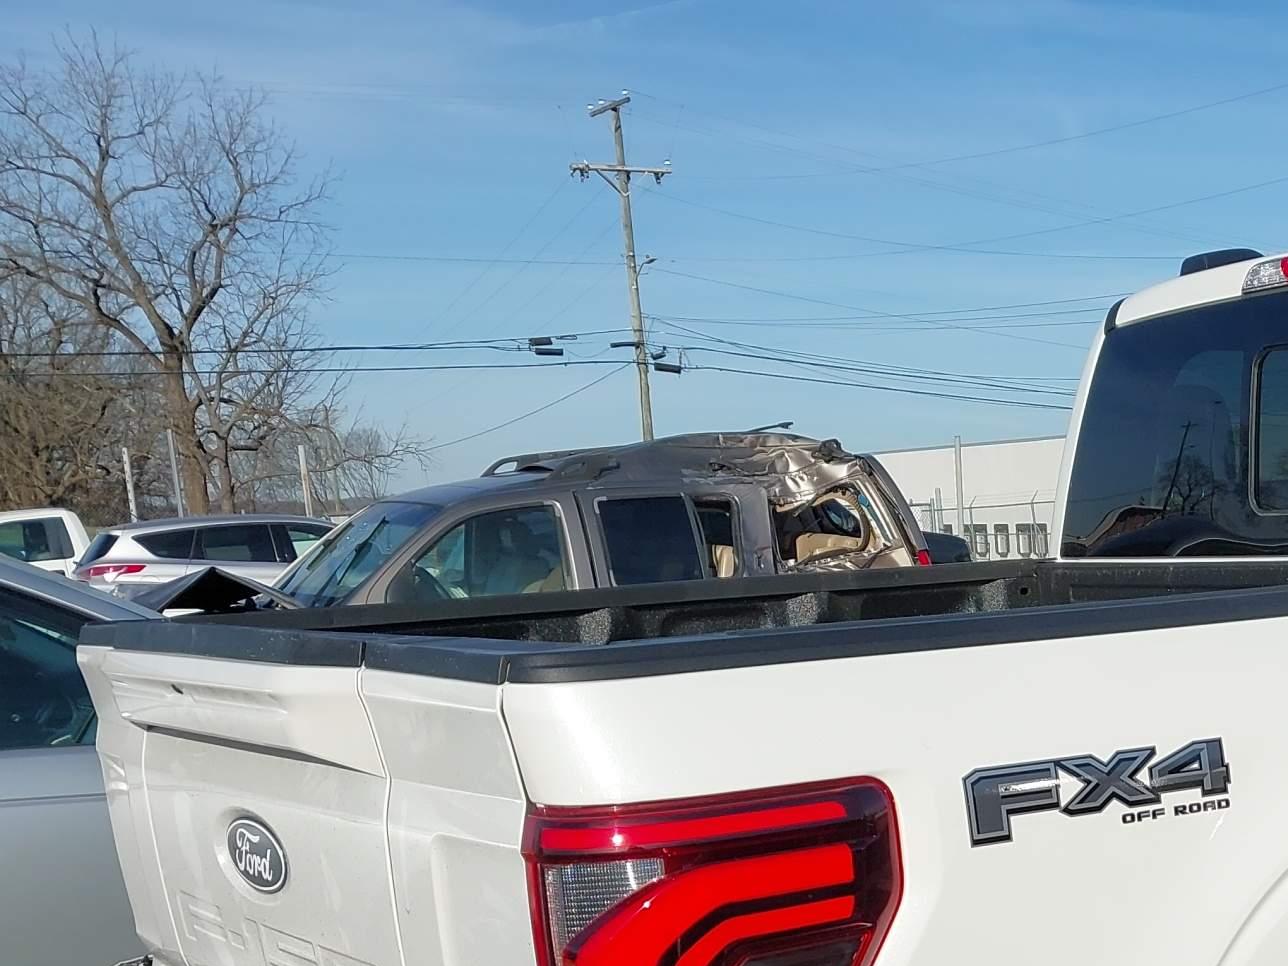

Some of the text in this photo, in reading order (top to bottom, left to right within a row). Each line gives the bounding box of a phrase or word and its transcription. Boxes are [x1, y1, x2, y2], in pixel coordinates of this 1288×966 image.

[961, 737, 1231, 848] FX4
[1121, 797, 1231, 825] OFF ROAD
[236, 828, 273, 881] Ford
